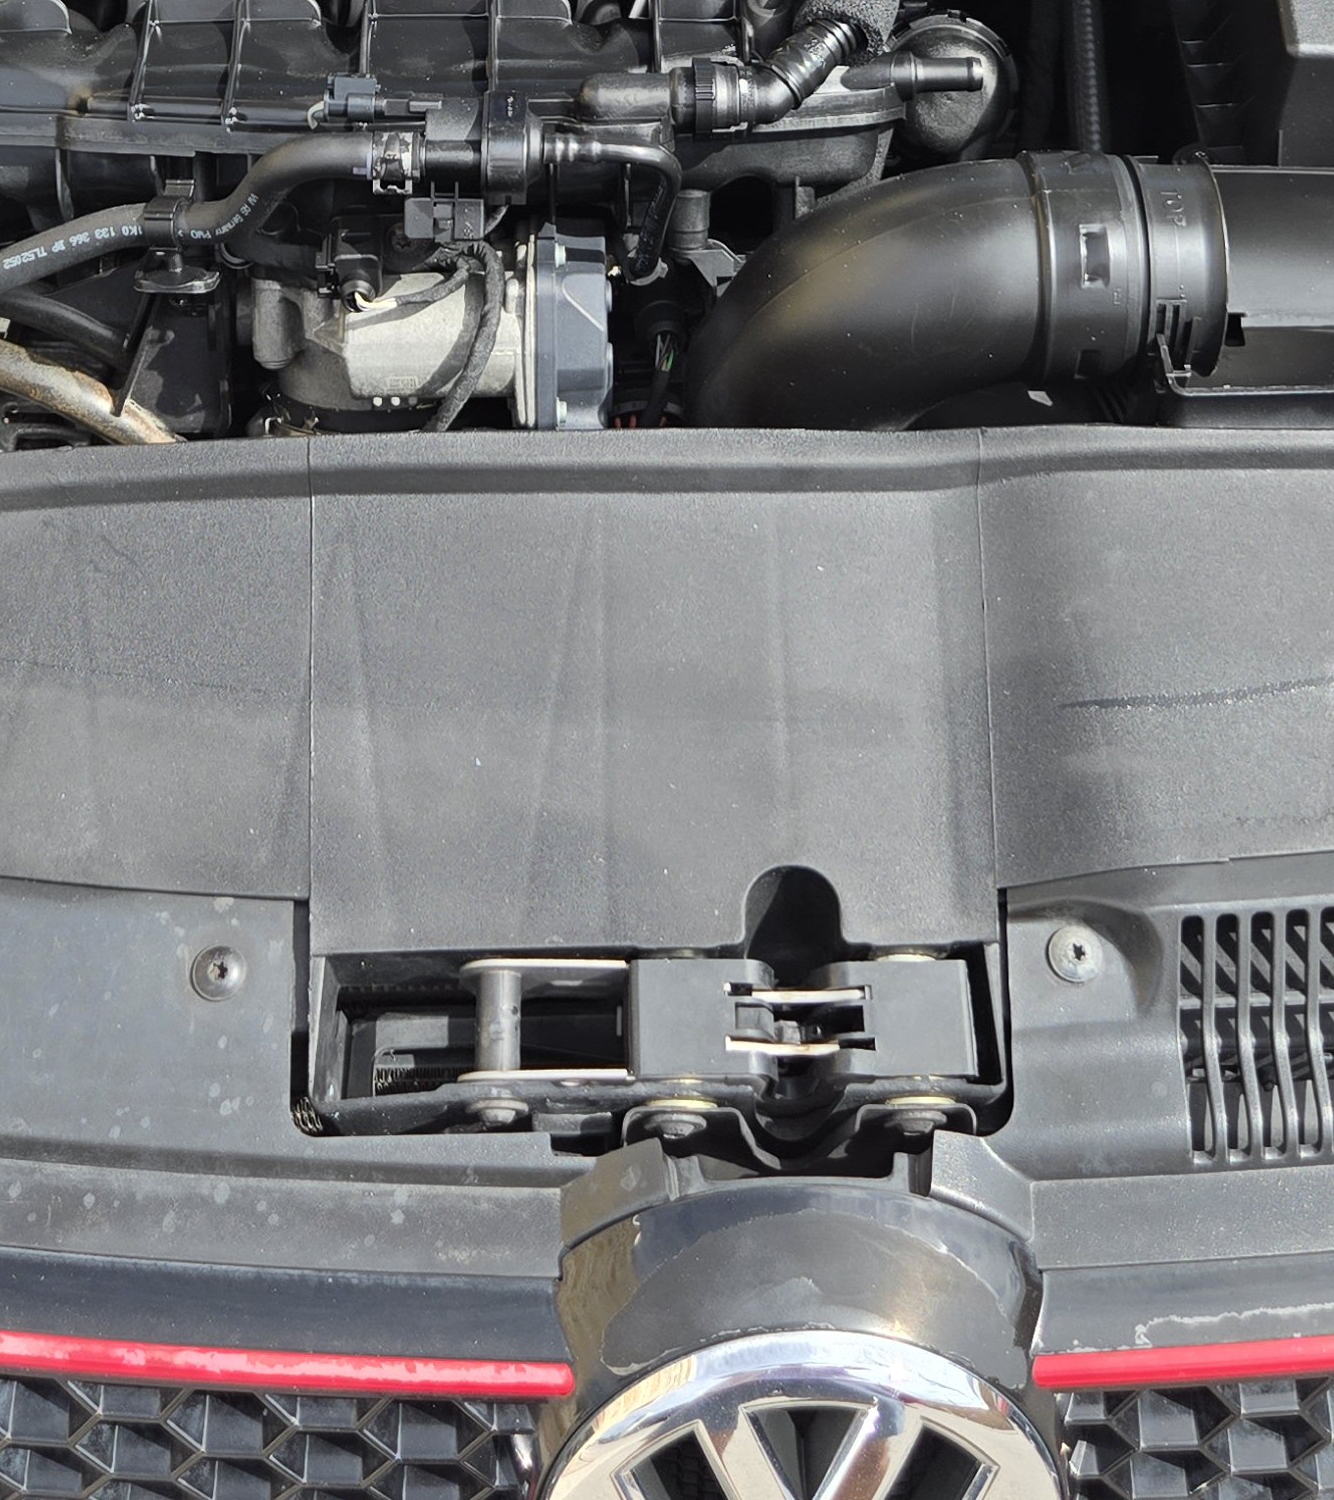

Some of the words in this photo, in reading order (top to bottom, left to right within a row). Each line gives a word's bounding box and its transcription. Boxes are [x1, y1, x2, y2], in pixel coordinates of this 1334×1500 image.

[1159, 187, 1186, 228] TOP
[69, 231, 90, 247] 366
[94, 225, 116, 240] 133
[121, 225, 144, 238] 1K0
[3, 246, 48, 270] TL52052
